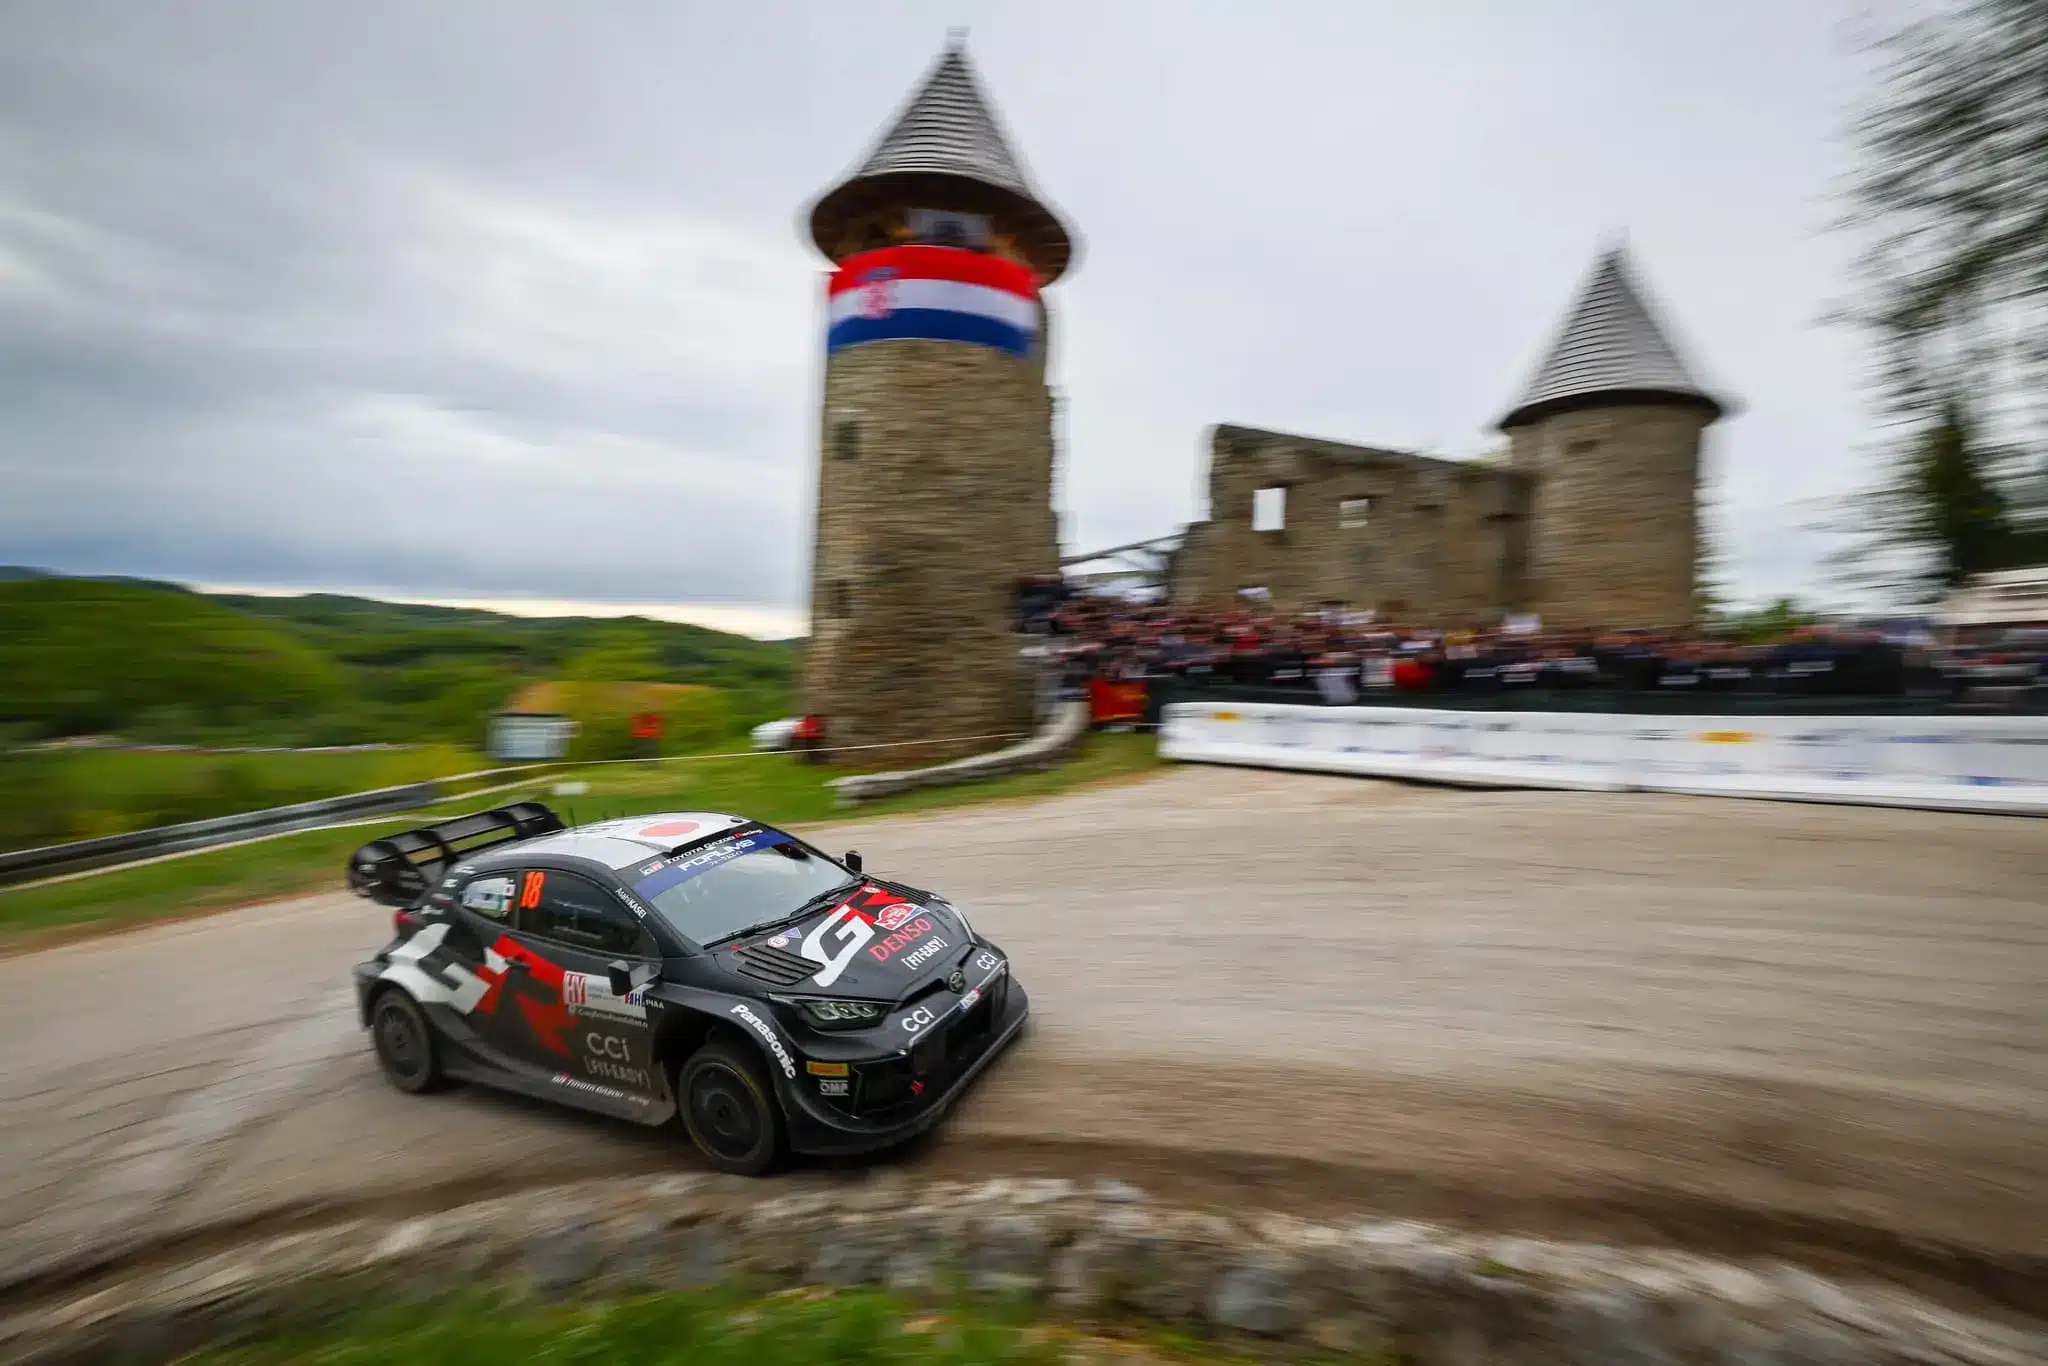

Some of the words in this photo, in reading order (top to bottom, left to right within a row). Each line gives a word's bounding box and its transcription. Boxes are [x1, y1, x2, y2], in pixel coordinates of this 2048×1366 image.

[664, 846, 704, 864] TOYOTA
[520, 871, 545, 909] 18
[869, 918, 932, 962] DENSO
[730, 1004, 797, 1080] Panasonic
